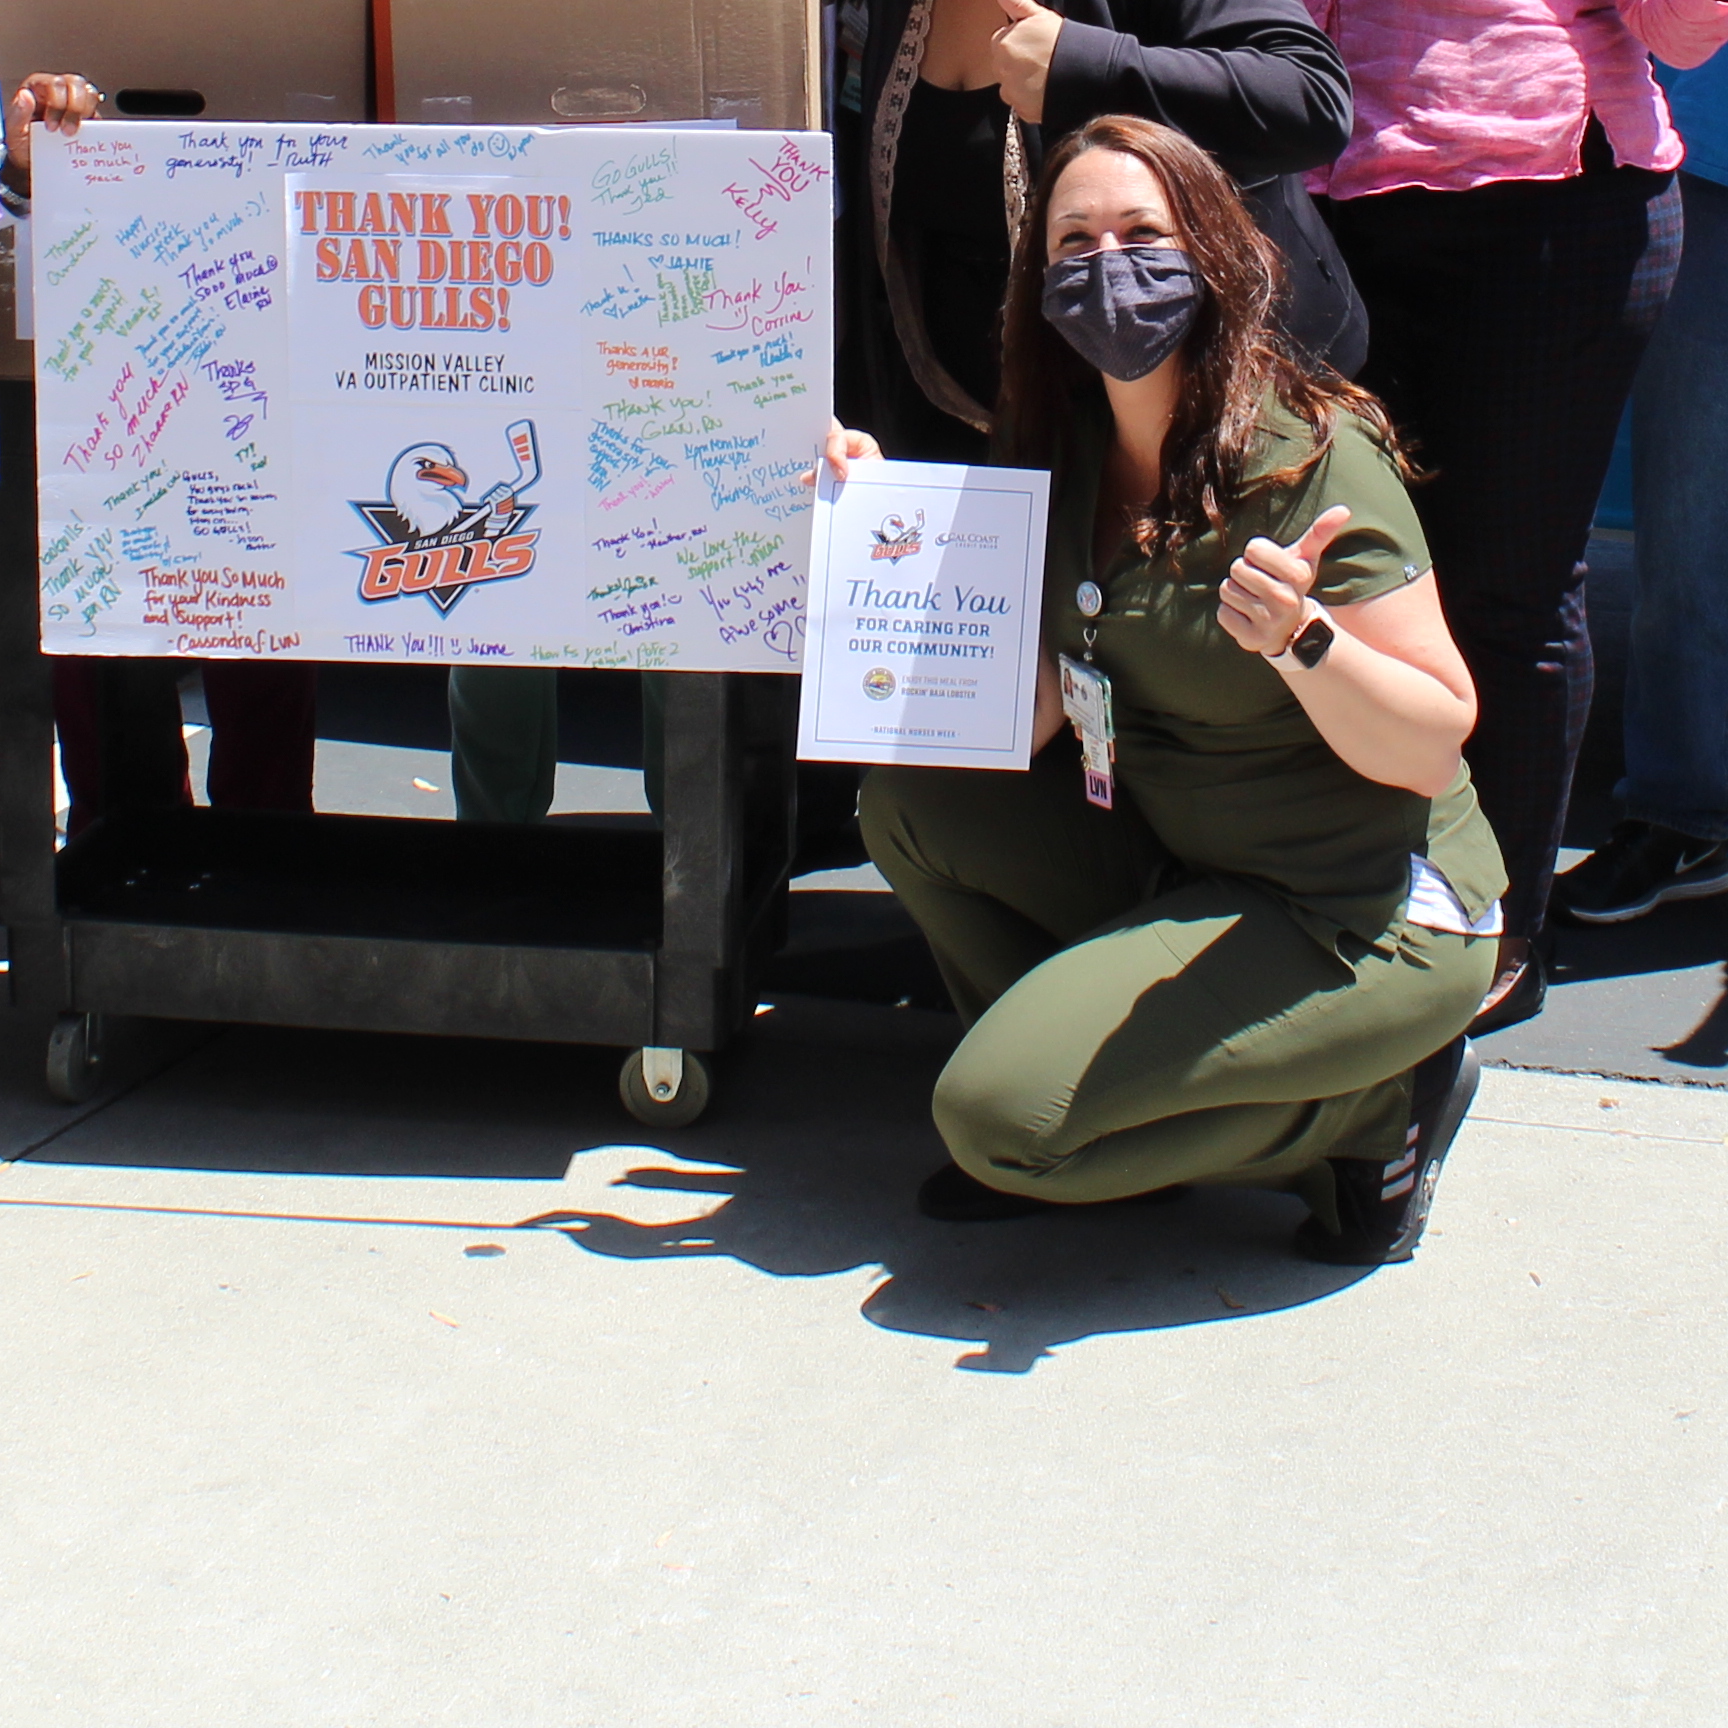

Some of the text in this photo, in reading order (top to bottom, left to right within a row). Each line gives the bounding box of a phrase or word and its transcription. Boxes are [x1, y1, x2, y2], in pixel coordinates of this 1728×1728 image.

[64, 140, 132, 156] Thank you
[178, 131, 229, 150] Thank
[237, 131, 263, 158] you
[309, 133, 349, 156] your
[362, 134, 407, 159] Thank
[72, 159, 87, 168] so
[779, 136, 829, 182] THANK
[772, 156, 810, 192] YOU
[591, 184, 634, 207] Thank
[295, 191, 571, 240] THANK YOU!
[153, 233, 192, 267] Thank
[592, 230, 741, 249] THANKS SO MUCH!
[315, 238, 553, 285] SAN DIEGO
[667, 256, 714, 271] JAMIE
[178, 263, 225, 289] Thank
[580, 288, 615, 316] Thank
[702, 278, 763, 311] Thank
[358, 285, 511, 332] GULLS!
[596, 341, 637, 356] Thanks
[202, 360, 256, 382] Thanks
[365, 353, 505, 373] MISSION VALLEY
[336, 371, 535, 394] VA OUTPATIENT CLINIC
[727, 373, 794, 393] Thank you
[62, 411, 110, 474] Thank
[592, 419, 628, 444] Thanks
[103, 480, 140, 511] Thank
[414, 532, 475, 549] SAN DIEGO
[592, 533, 630, 552] Thank
[967, 534, 999, 543] COAST
[356, 530, 541, 600] GULLS
[677, 549, 699, 565] We
[41, 557, 85, 597] Thank
[139, 566, 285, 596] Thank you So Much
[143, 590, 271, 619] for your Kindness
[846, 578, 1011, 615] Thank You
[175, 610, 244, 629] Support!
[598, 603, 637, 623] Thank
[855, 617, 990, 637] FOR CARING FOR
[343, 636, 394, 653] THANK
[848, 638, 995, 658] OUR COMMUNITY!
[1089, 775, 1107, 800] LVN
